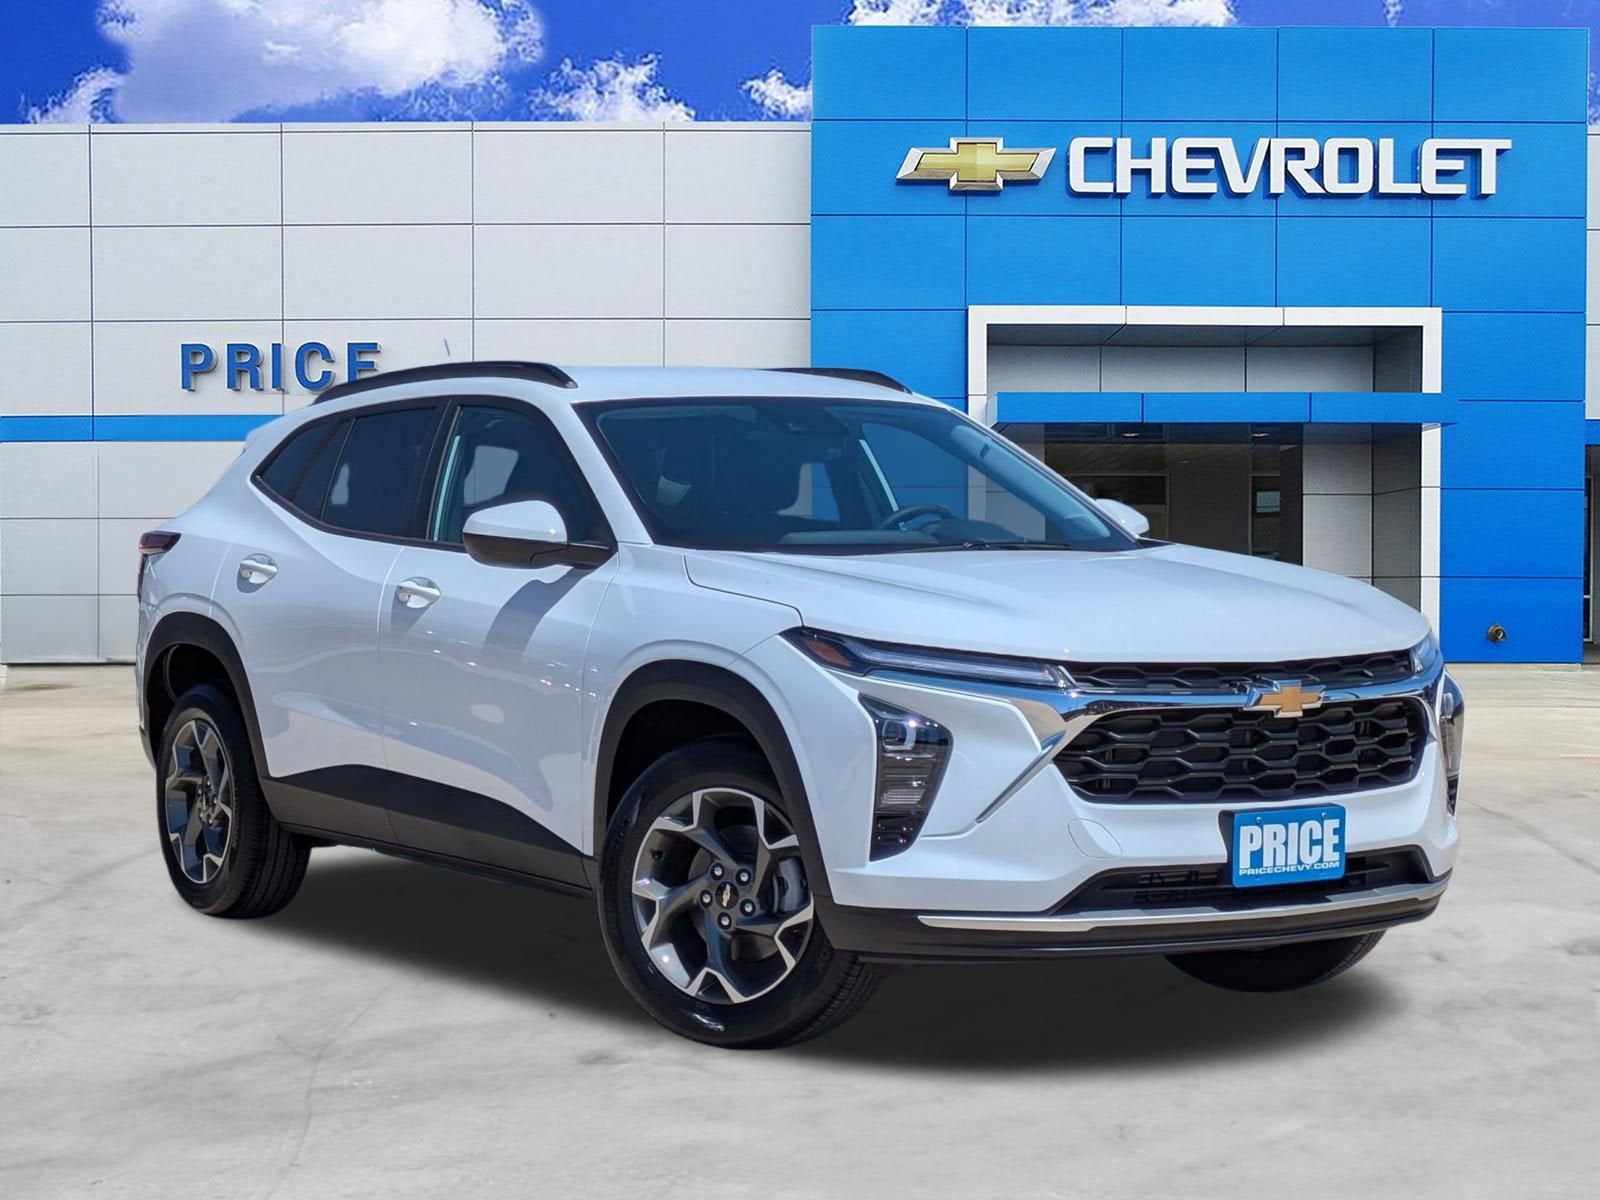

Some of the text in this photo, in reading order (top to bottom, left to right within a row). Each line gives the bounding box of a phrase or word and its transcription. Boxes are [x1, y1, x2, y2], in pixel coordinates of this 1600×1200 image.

[1069, 137, 1512, 195] CHEVROLET
[180, 341, 380, 391] PRICE
[1239, 819, 1340, 869] PRICE
[1239, 861, 1340, 876] PRICECHEVY.COM
